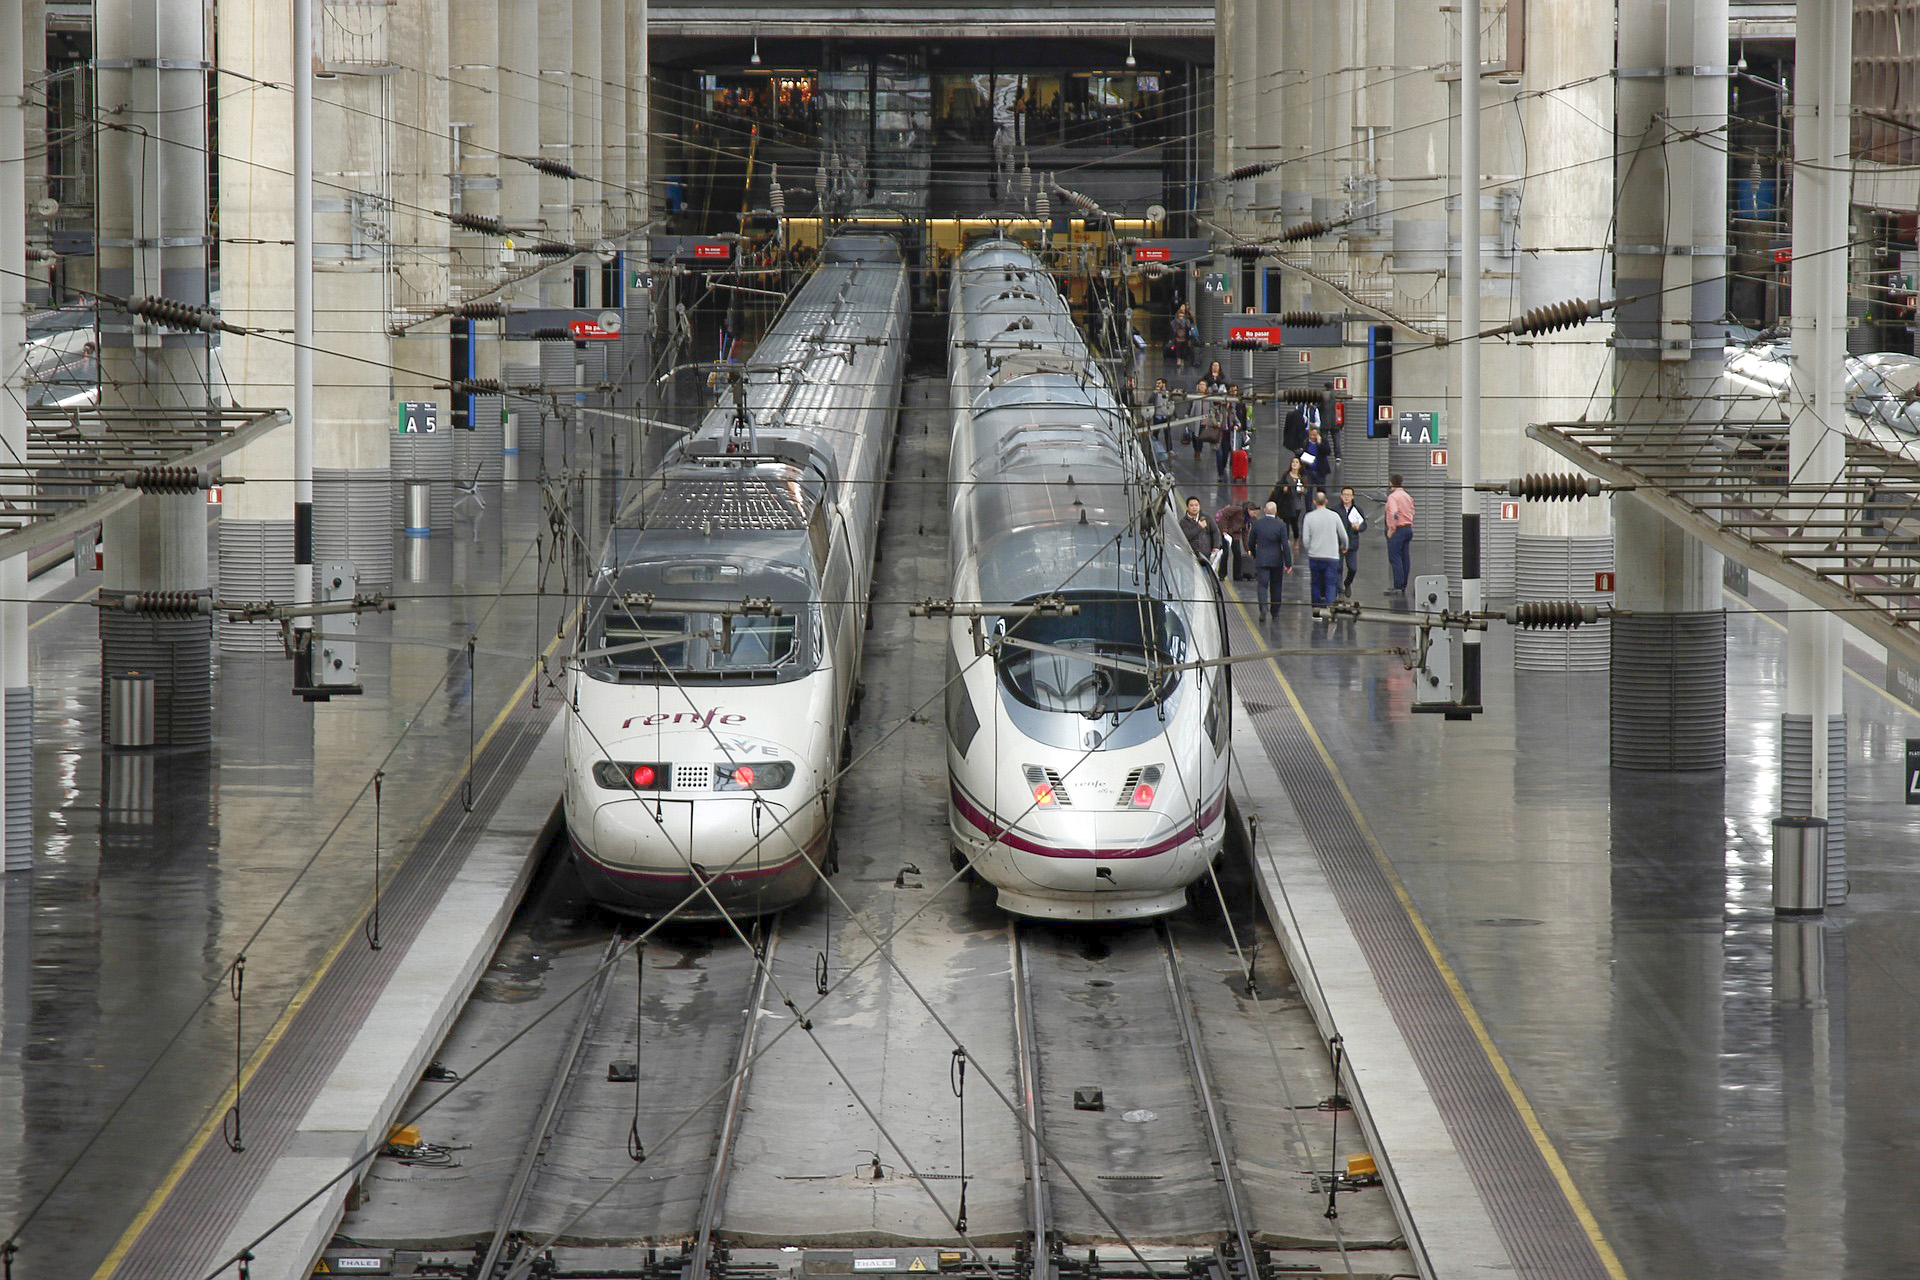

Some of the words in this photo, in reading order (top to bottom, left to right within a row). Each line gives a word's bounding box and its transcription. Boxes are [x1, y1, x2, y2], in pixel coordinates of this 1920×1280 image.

[636, 278, 642, 288] A
[646, 278, 653, 288] 5
[1206, 281, 1213, 291] 4
[1216, 281, 1224, 291] A
[406, 417, 418, 432] A
[426, 417, 436, 433] 5
[1400, 427, 1412, 443] 4
[1419, 427, 1431, 443] A
[622, 706, 746, 730] renfe
[713, 738, 778, 756] AVE
